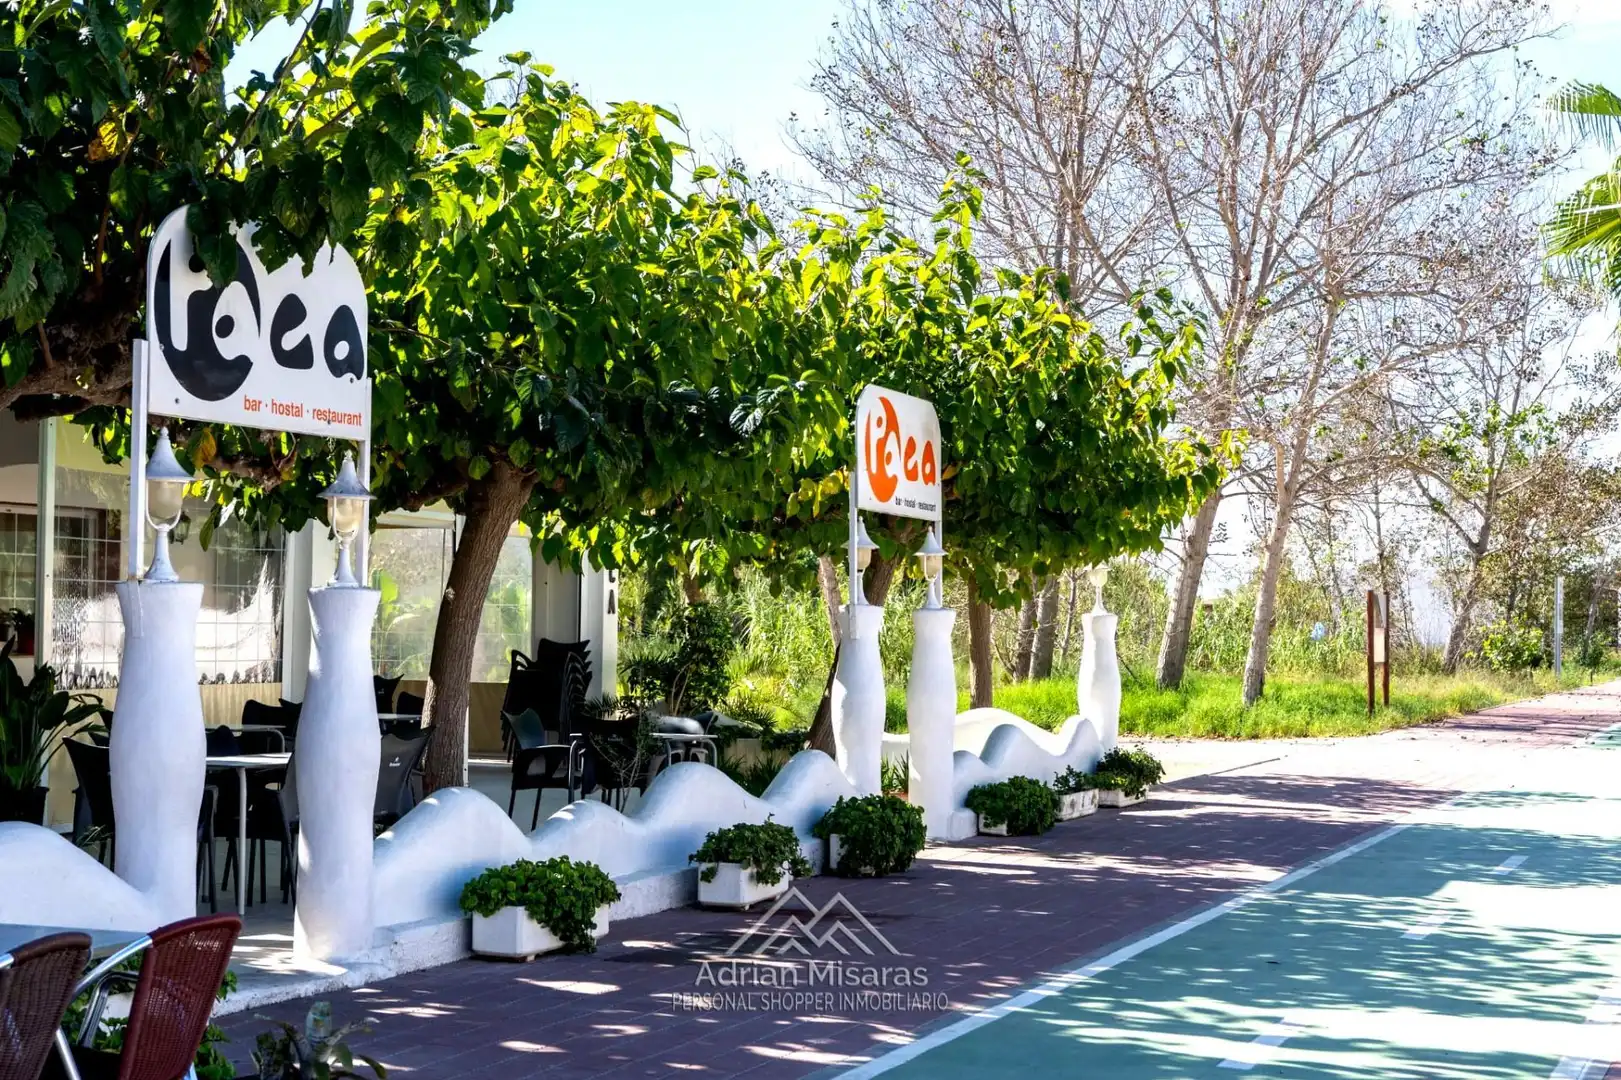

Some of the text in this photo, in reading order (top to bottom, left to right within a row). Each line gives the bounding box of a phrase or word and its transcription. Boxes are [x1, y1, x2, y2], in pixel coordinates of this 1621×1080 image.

[244, 394, 362, 427] bar hostal restaurant
